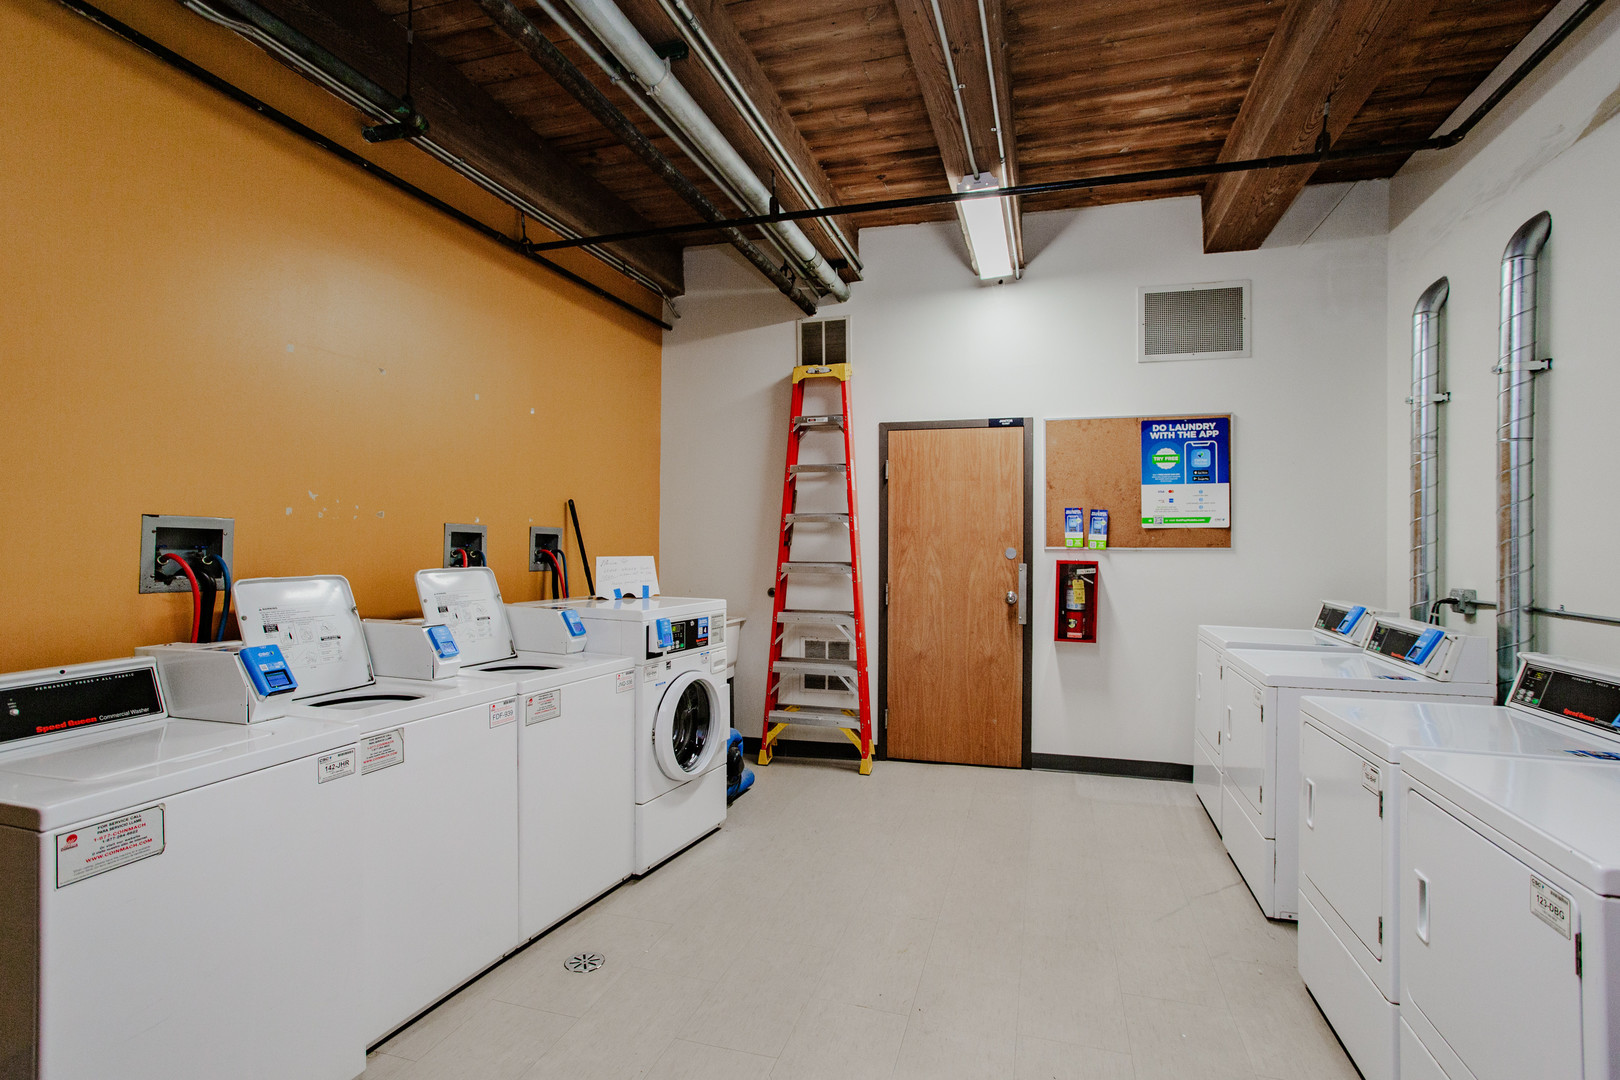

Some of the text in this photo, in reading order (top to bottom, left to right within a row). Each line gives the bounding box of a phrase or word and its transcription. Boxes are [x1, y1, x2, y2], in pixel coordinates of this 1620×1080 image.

[1152, 422, 1216, 432] DO LAUNDRY
[1177, 431, 1197, 439] THE
[1199, 430, 1219, 438] APP
[35, 682, 72, 691] PERMANENT
[493, 710, 513, 720] FDF-939
[36, 707, 150, 734] Speed Queen Commercial Washer
[325, 760, 350, 772] 142-JHR
[109, 817, 129, 826] SERVICE
[109, 822, 128, 831] SERVICIO
[94, 823, 146, 842] 1-877-COINMACH
[85, 838, 152, 863] WWW.COINMACH.COM
